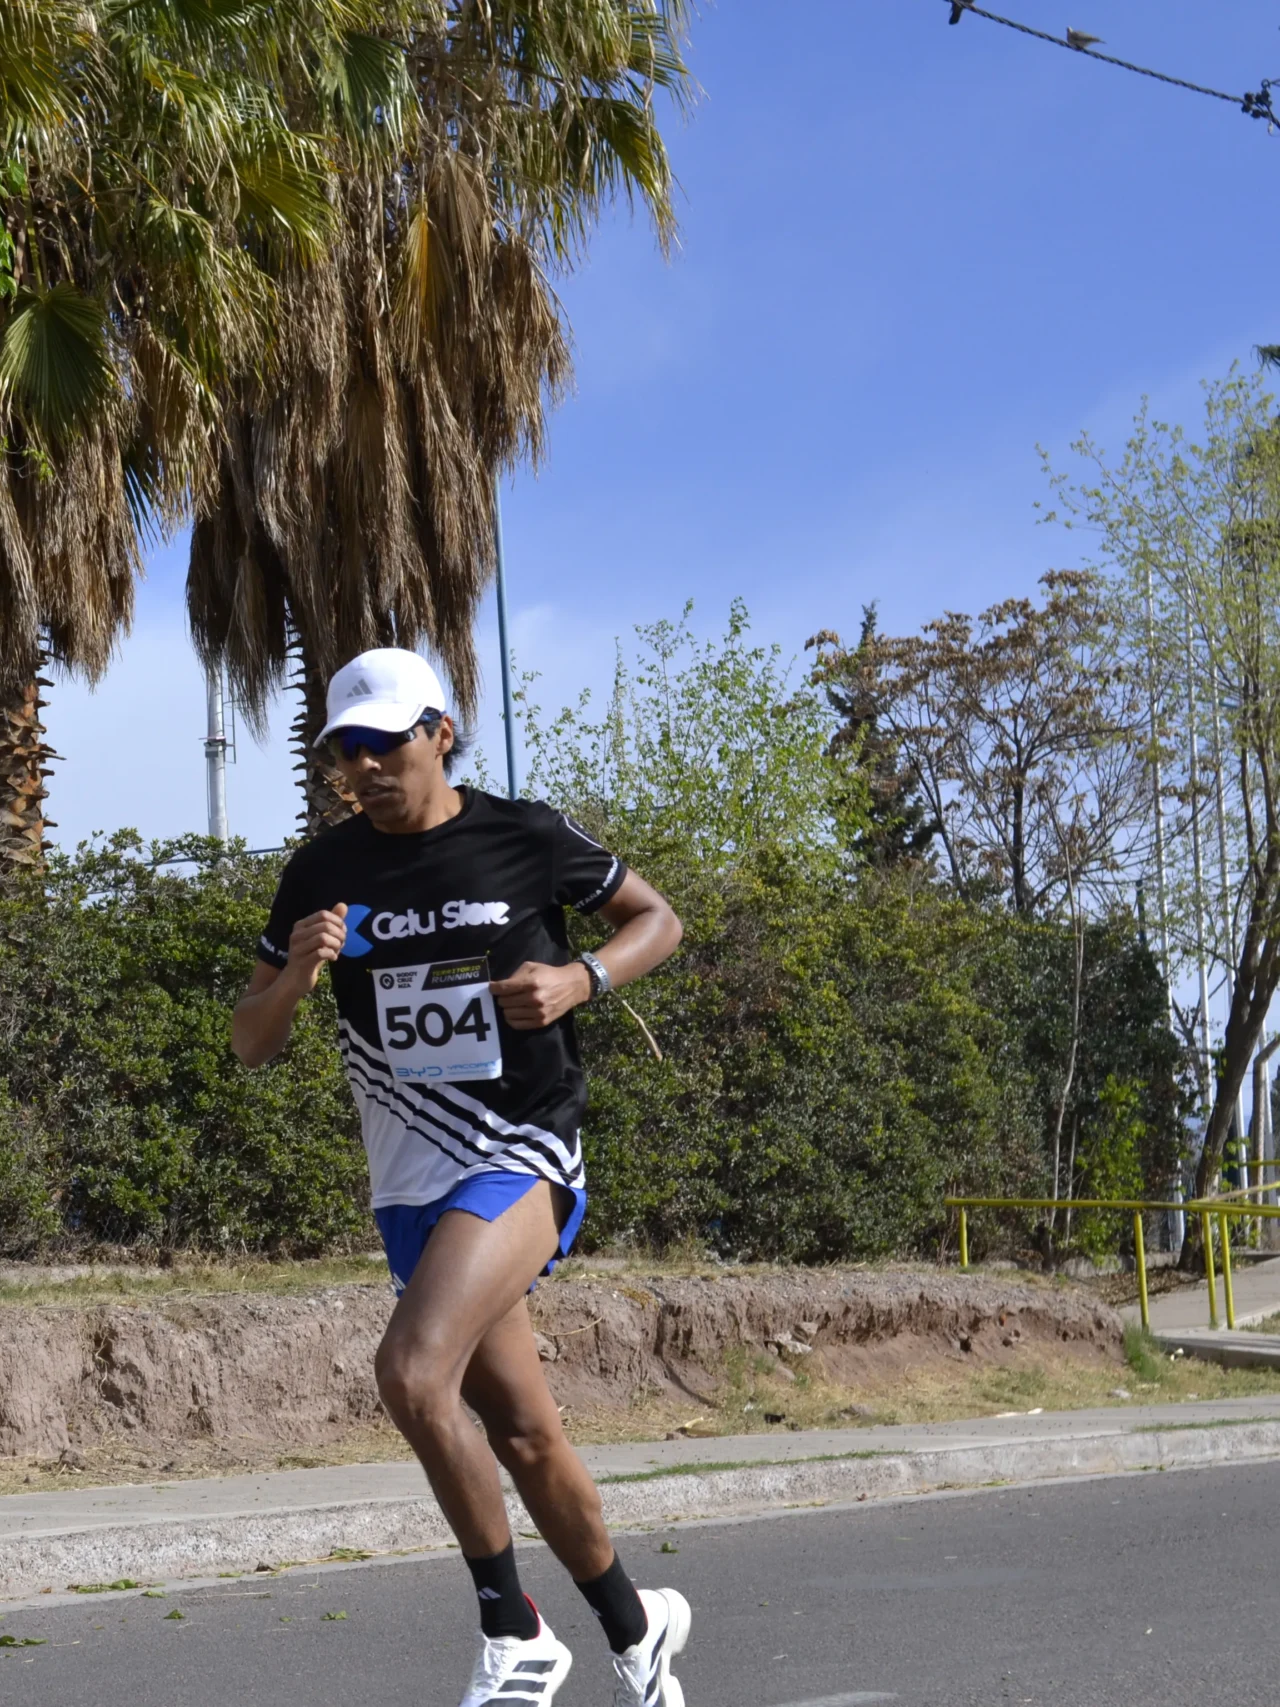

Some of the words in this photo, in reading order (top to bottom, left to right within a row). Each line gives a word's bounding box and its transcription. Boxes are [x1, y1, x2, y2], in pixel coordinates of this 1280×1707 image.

[431, 971, 480, 984] RUNNING
[385, 997, 491, 1051] 504
[395, 1066, 443, 1077] BYD
